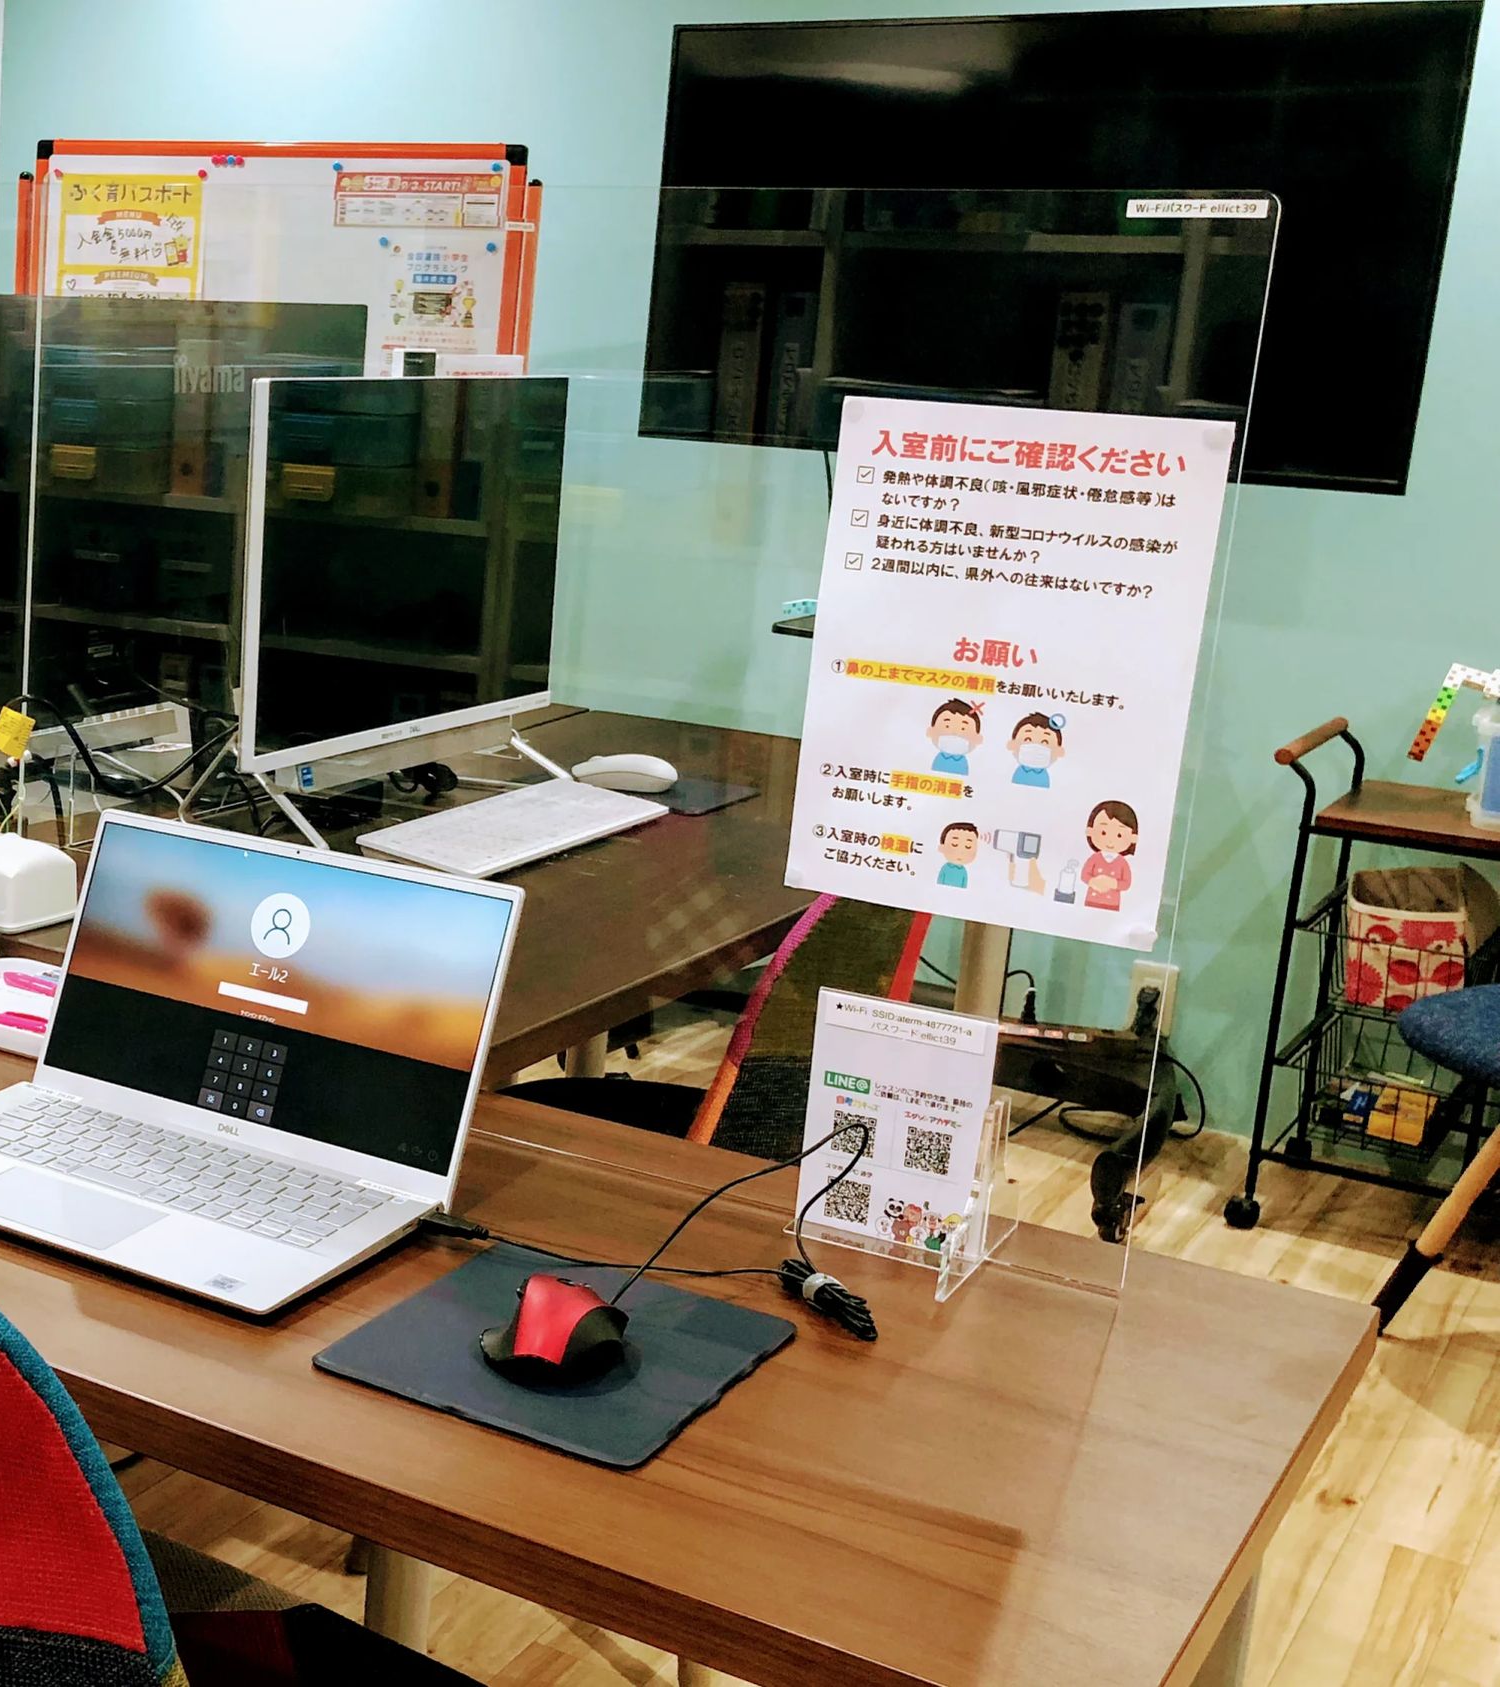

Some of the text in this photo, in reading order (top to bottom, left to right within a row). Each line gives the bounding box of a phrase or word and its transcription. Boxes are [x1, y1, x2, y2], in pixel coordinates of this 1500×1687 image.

[871, 429, 1187, 478] 入室前にご確認ください
[881, 493, 960, 512] ないですか？
[876, 513, 1179, 556] 身近に体調不良、新型コロナウイルスの感染が
[875, 535, 1040, 564] 疑われる方はいませんか？
[953, 636, 1038, 668] お願い
[831, 784, 914, 811] お願いします。
[823, 847, 917, 877] ご協力ください。
[248, 962, 290, 984] エール2
[826, 1072, 869, 1092] LINE@
[217, 1123, 240, 1137] DELL
